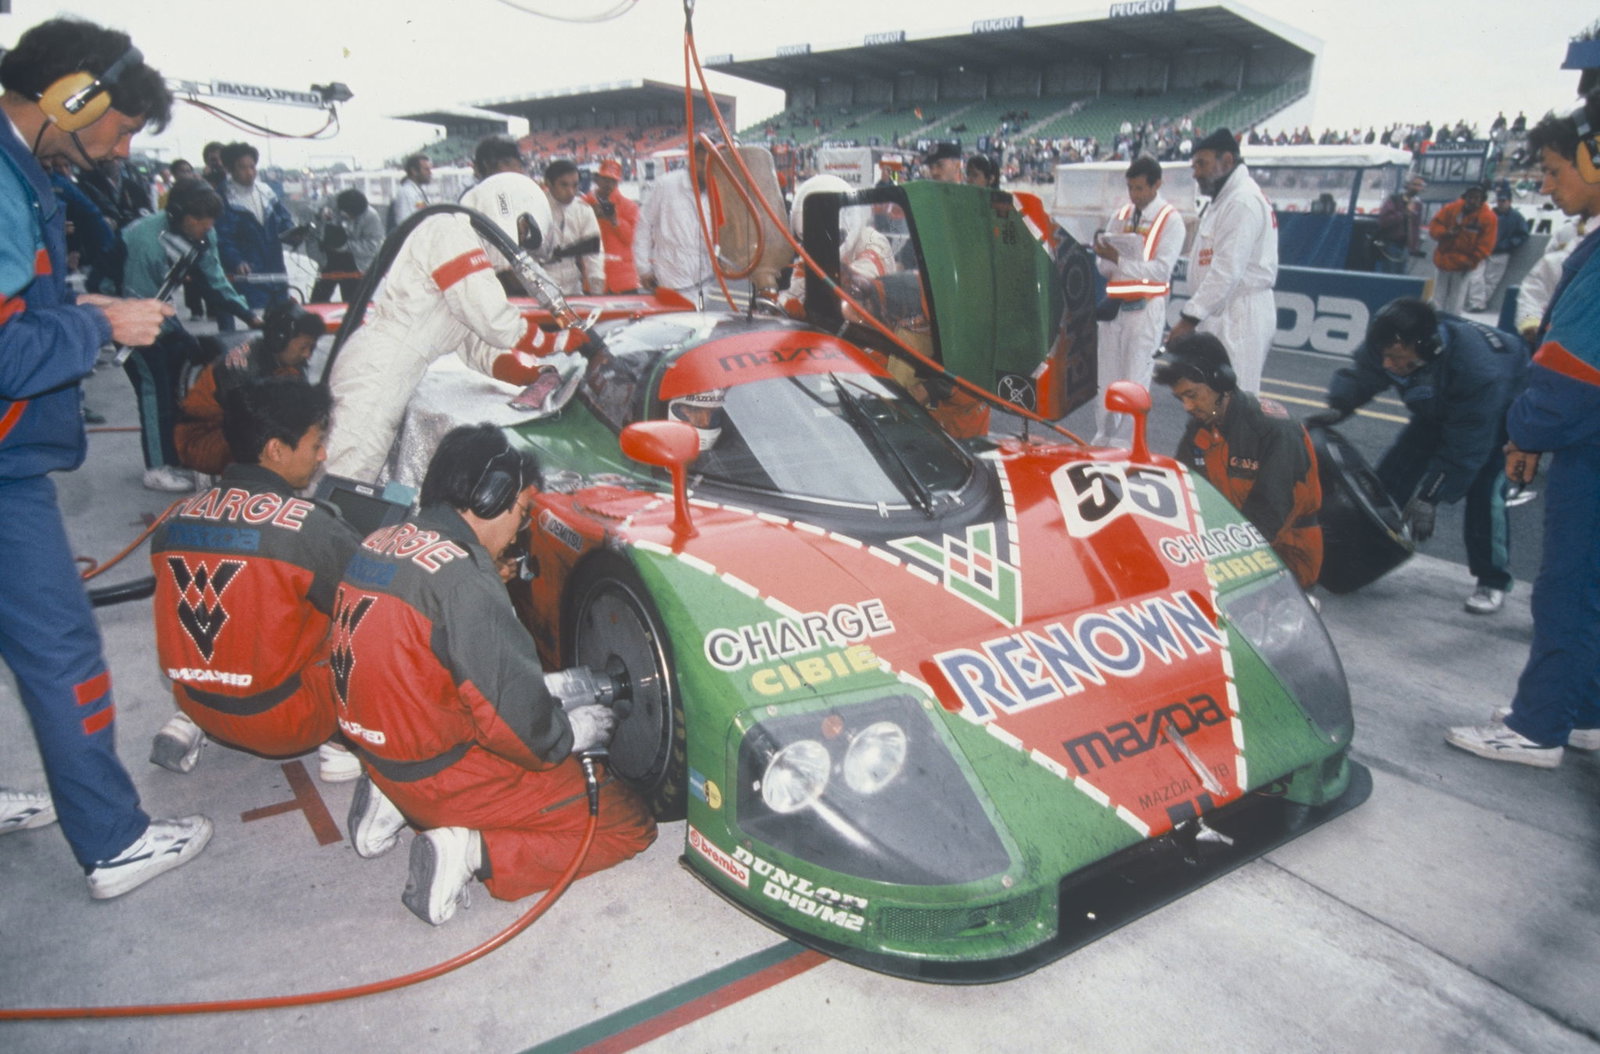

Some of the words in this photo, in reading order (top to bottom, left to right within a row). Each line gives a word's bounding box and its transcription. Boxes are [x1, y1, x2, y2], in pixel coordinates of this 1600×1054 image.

[973, 17, 1020, 33] PEUGEOT
[1112, 0, 1169, 17] PEUGEOT
[1066, 463, 1178, 522] 55
[1160, 522, 1269, 566] CHARGE
[706, 600, 894, 669] CHARGE
[934, 591, 1227, 723] RENOWN
[1062, 693, 1227, 775] mazda
[1138, 779, 1193, 811] MAZDA
[701, 838, 746, 881] brembo
[731, 845, 868, 909] DUNLOP
